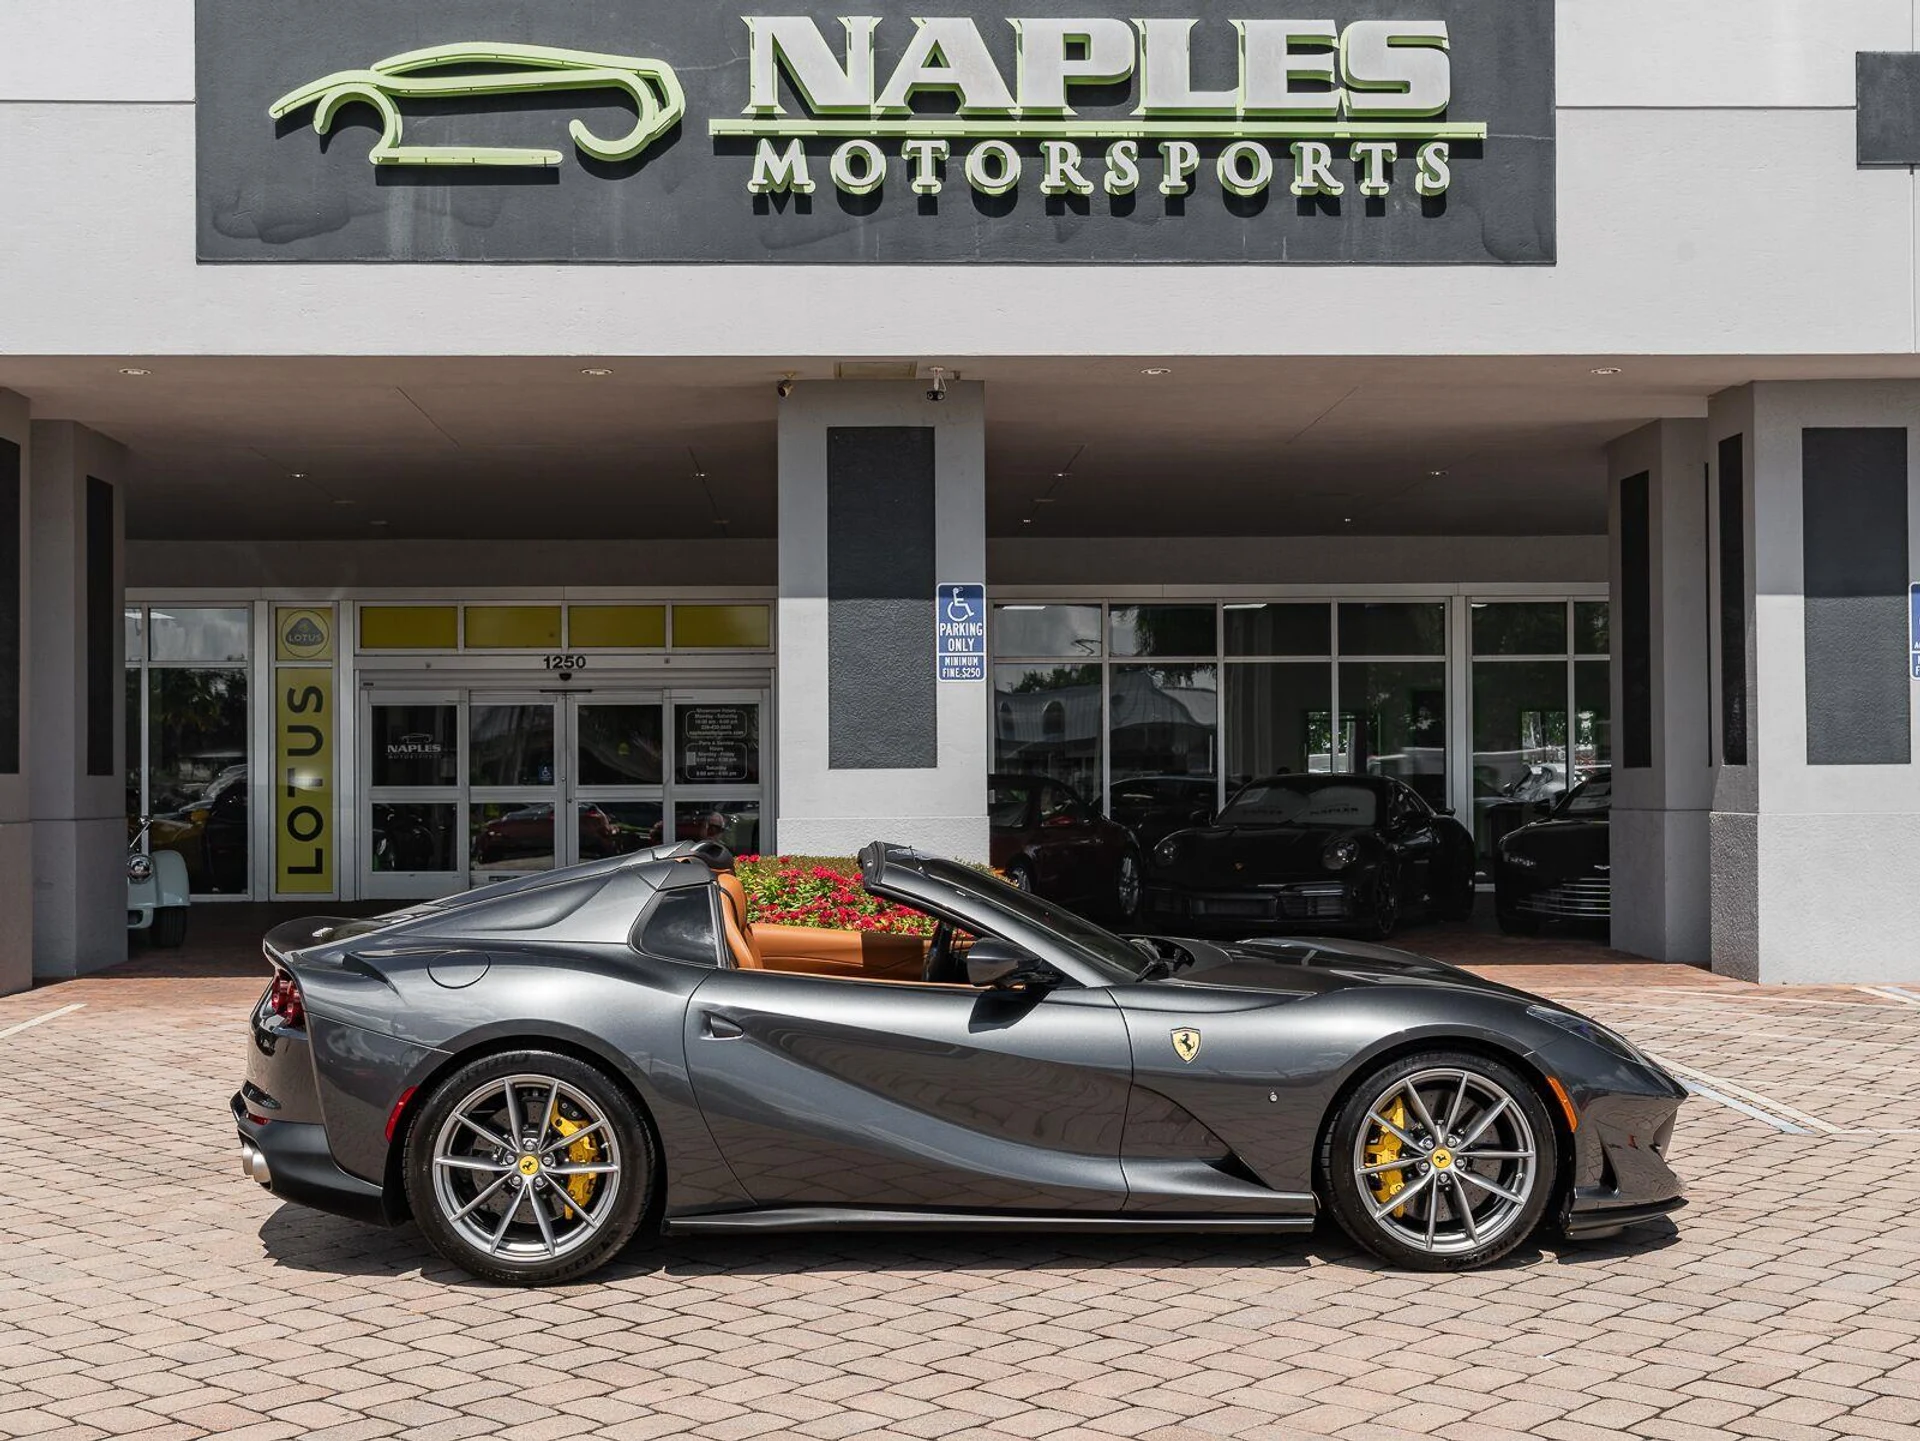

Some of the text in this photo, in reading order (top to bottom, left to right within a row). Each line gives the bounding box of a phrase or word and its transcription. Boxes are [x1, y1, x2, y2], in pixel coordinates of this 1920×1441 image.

[741, 16, 1450, 117] NAPLES
[748, 138, 1450, 195] MOTORSPORTS
[940, 622, 983, 636] PARKING
[289, 633, 321, 642] LOTUS
[947, 637, 975, 652] ONLY
[543, 655, 586, 669] 1250
[944, 656, 978, 666] MINIMUM
[387, 744, 441, 753] NAPLES
[286, 685, 324, 875] LOTUS
